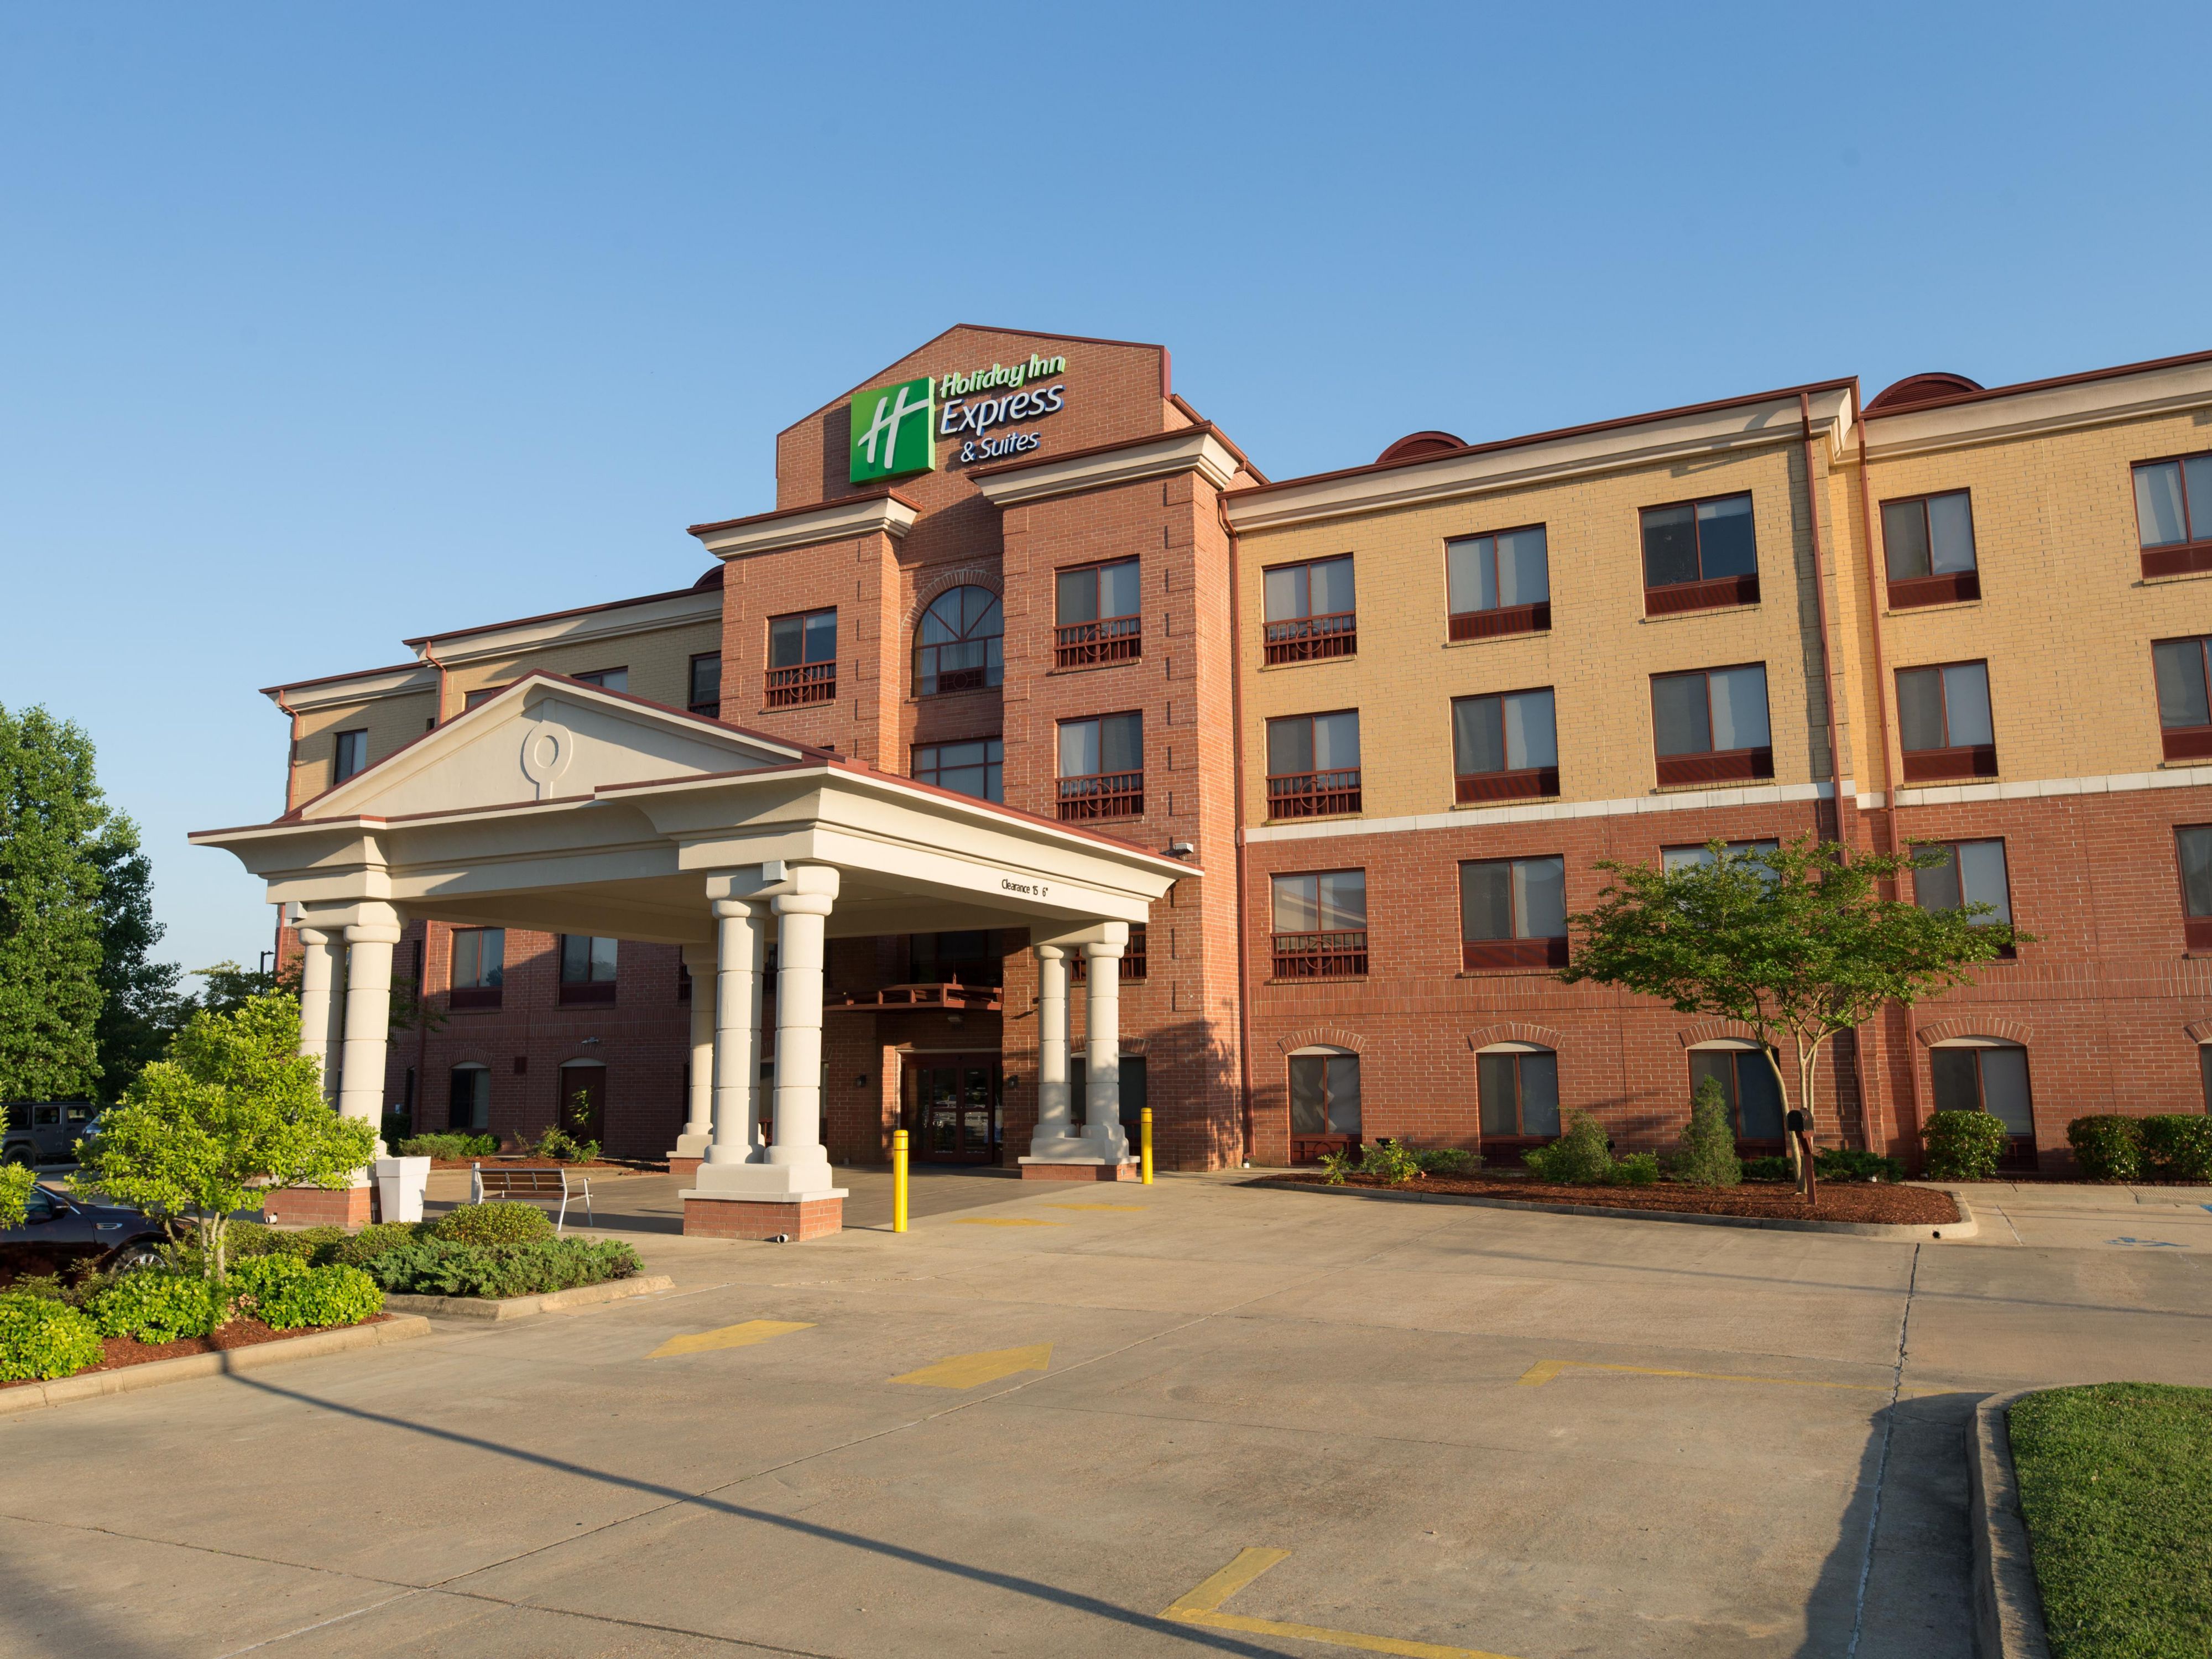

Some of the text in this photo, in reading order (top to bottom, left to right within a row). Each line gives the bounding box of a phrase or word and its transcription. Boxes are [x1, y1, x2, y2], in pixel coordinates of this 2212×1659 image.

[940, 353, 1066, 398] Holiday Inn
[941, 385, 1065, 436] Express
[961, 431, 1041, 462] & Suites
[1001, 879, 1030, 894] Clearance
[1032, 885, 1039, 895] 15
